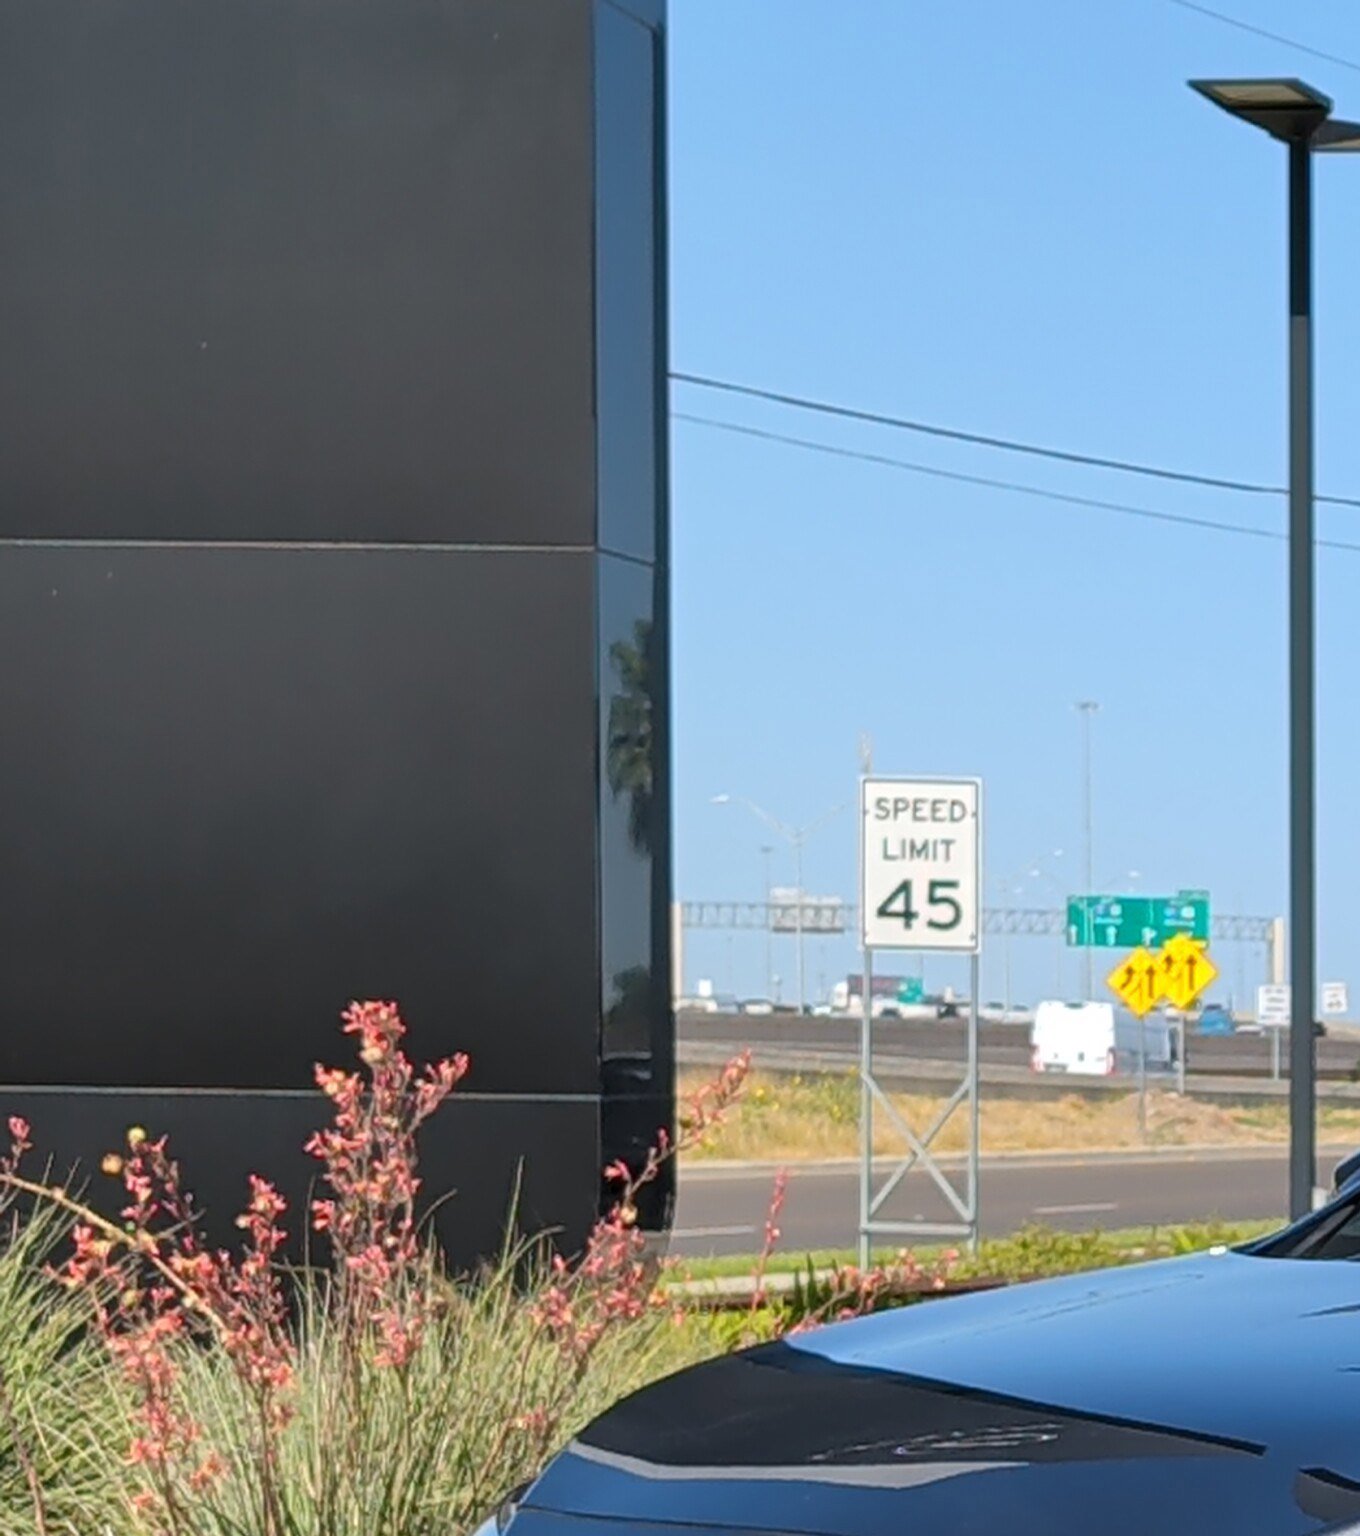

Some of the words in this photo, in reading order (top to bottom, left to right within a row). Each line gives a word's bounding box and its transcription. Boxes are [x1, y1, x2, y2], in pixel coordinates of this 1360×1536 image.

[875, 797, 967, 823] SPEED
[882, 837, 956, 862] LIMIT
[876, 878, 963, 931] 45
